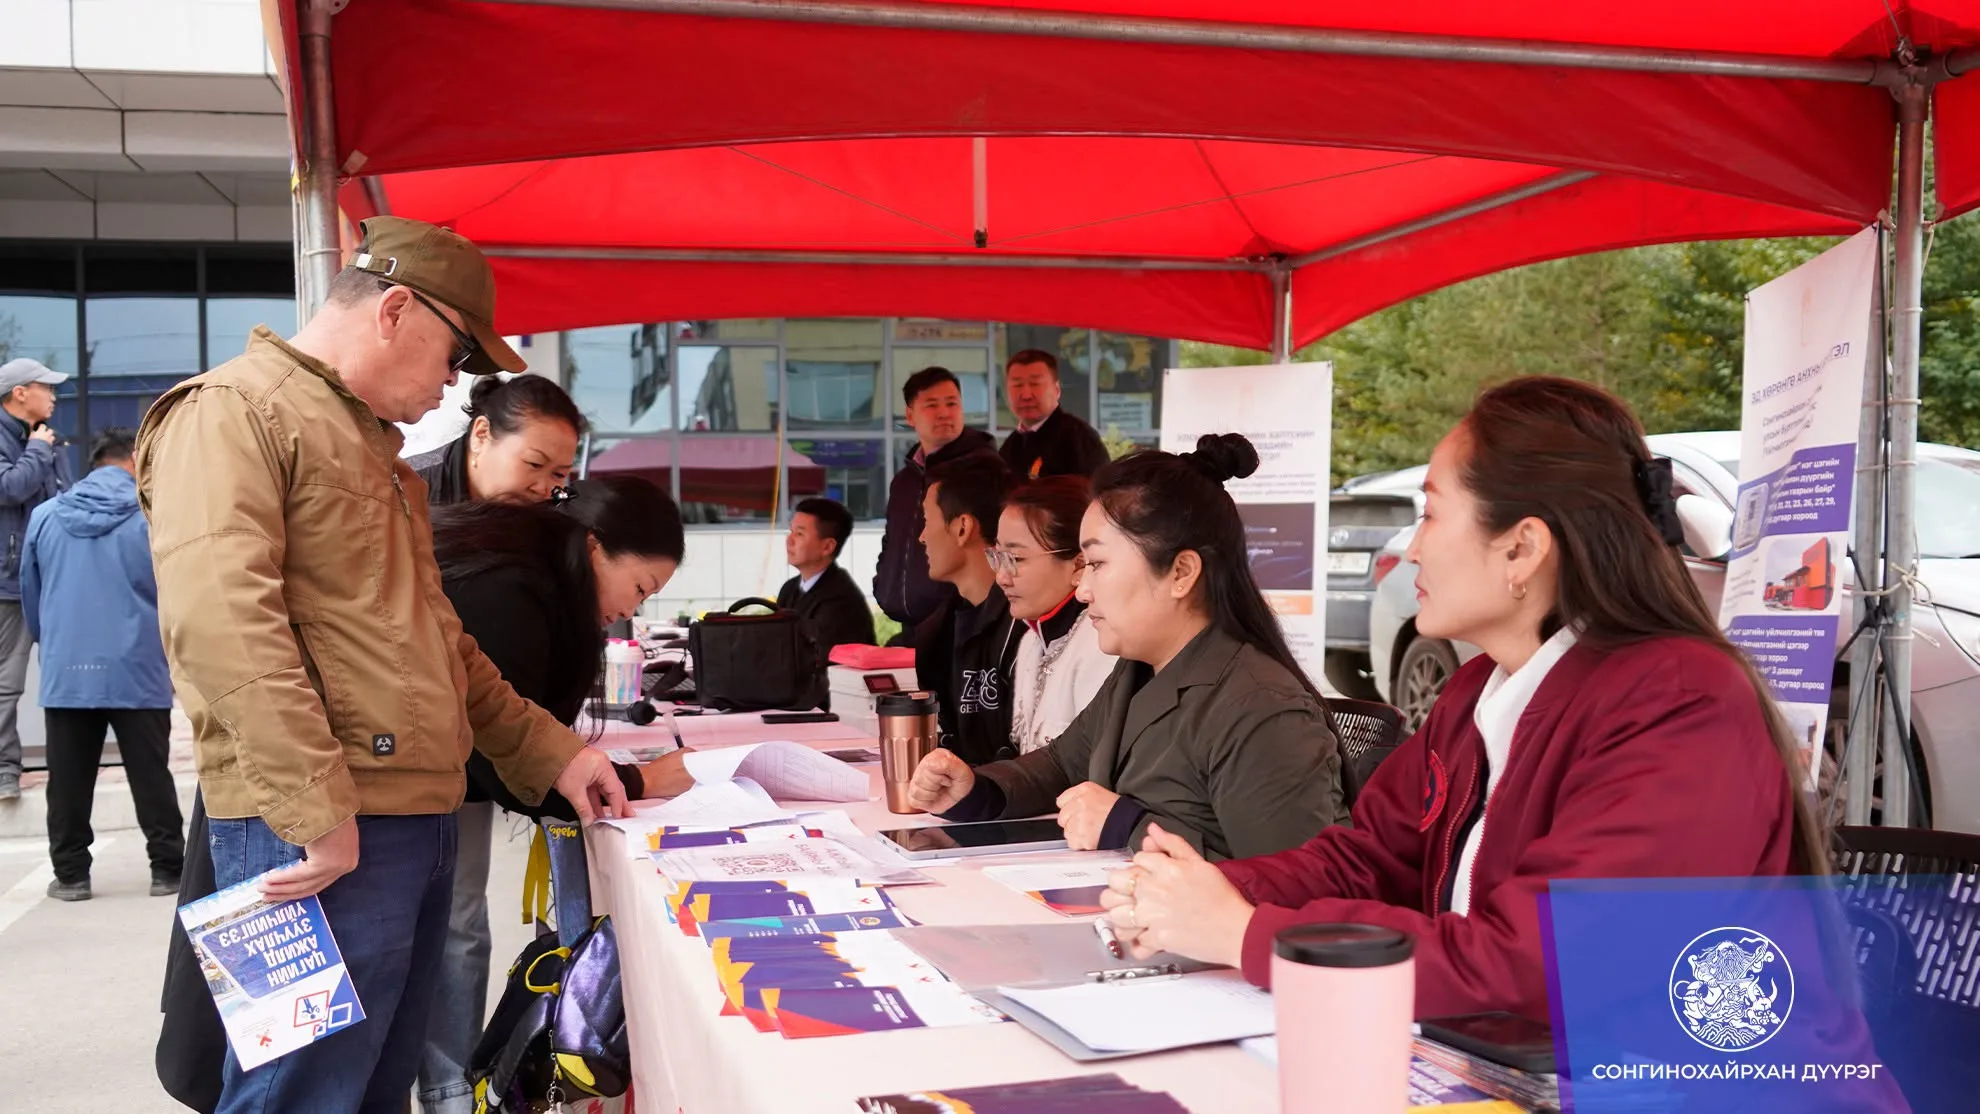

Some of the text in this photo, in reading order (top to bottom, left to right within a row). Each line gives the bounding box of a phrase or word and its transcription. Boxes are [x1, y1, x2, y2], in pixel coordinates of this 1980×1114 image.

[218, 901, 308, 948] ҮЙЛЧИЛГЭЭ
[244, 917, 313, 957] ЗУУЧЛАХ
[263, 933, 319, 969] АЖИЛД
[266, 951, 327, 988] ЦАГИЙН
